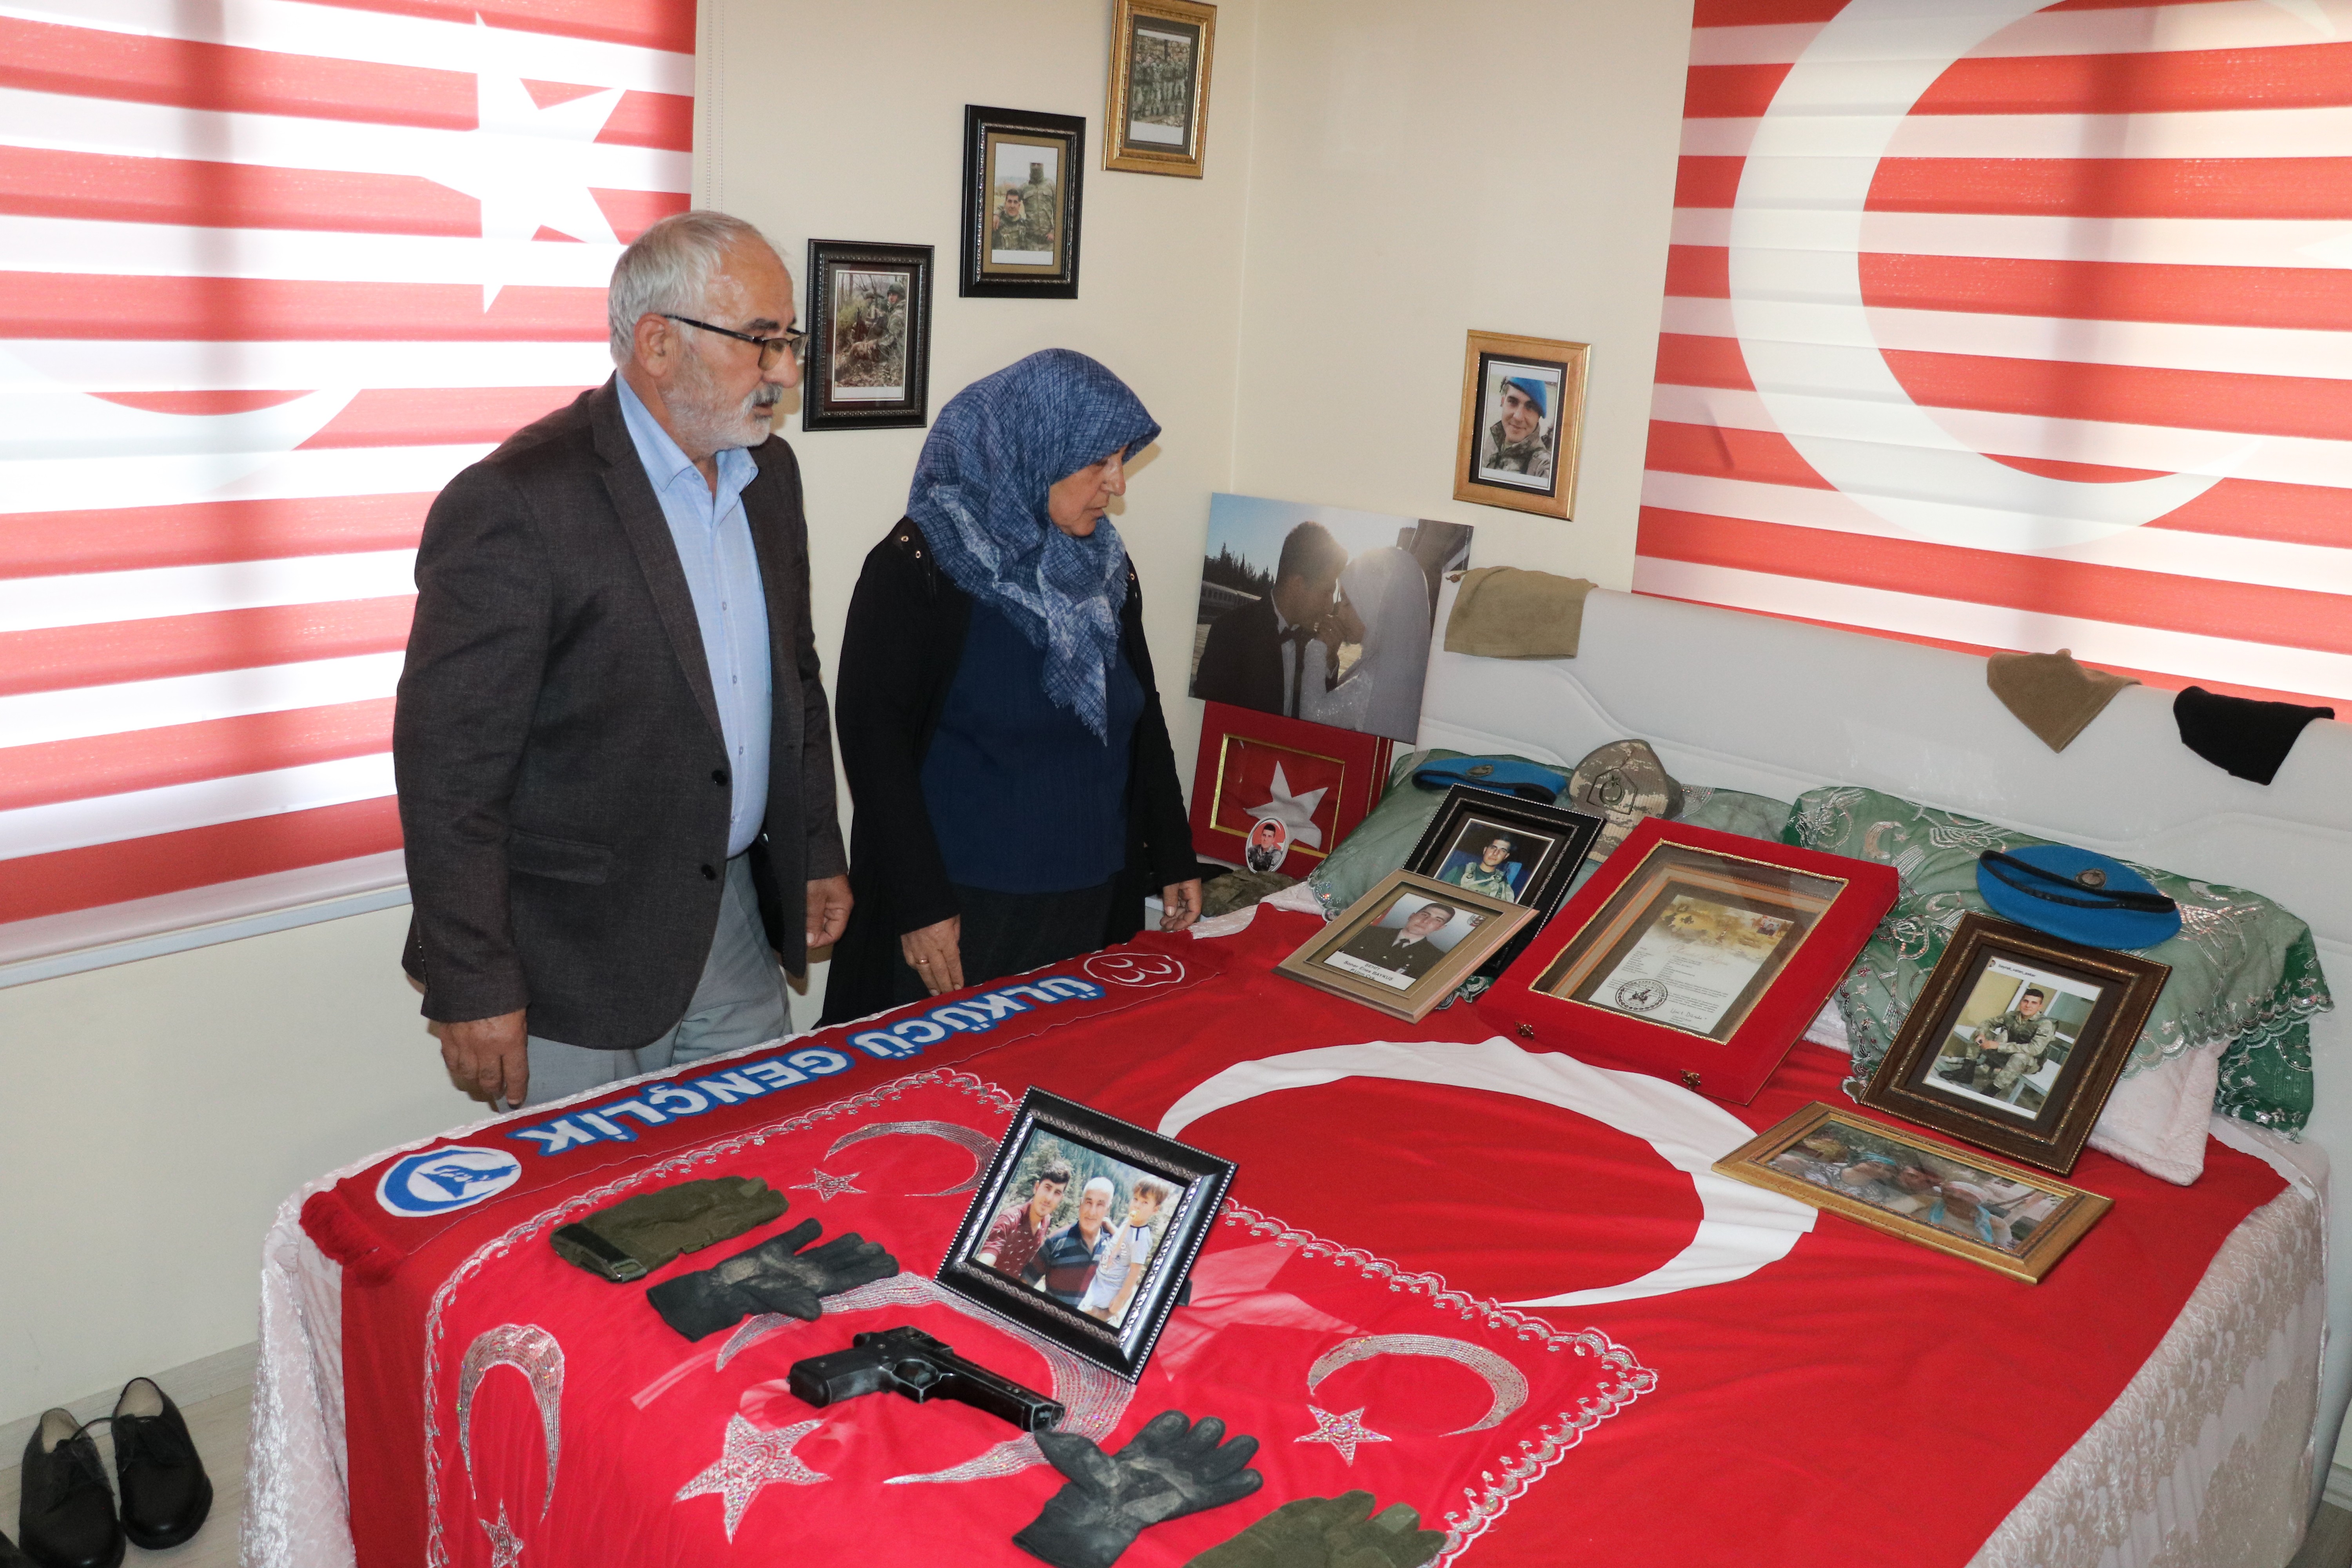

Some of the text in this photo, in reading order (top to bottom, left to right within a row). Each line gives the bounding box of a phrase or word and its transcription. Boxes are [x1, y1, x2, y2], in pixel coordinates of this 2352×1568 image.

[1372, 971, 1394, 981] BAYKUŞ
[513, 976, 1100, 1154] ÜLKÜCÜ GENÇLİK
